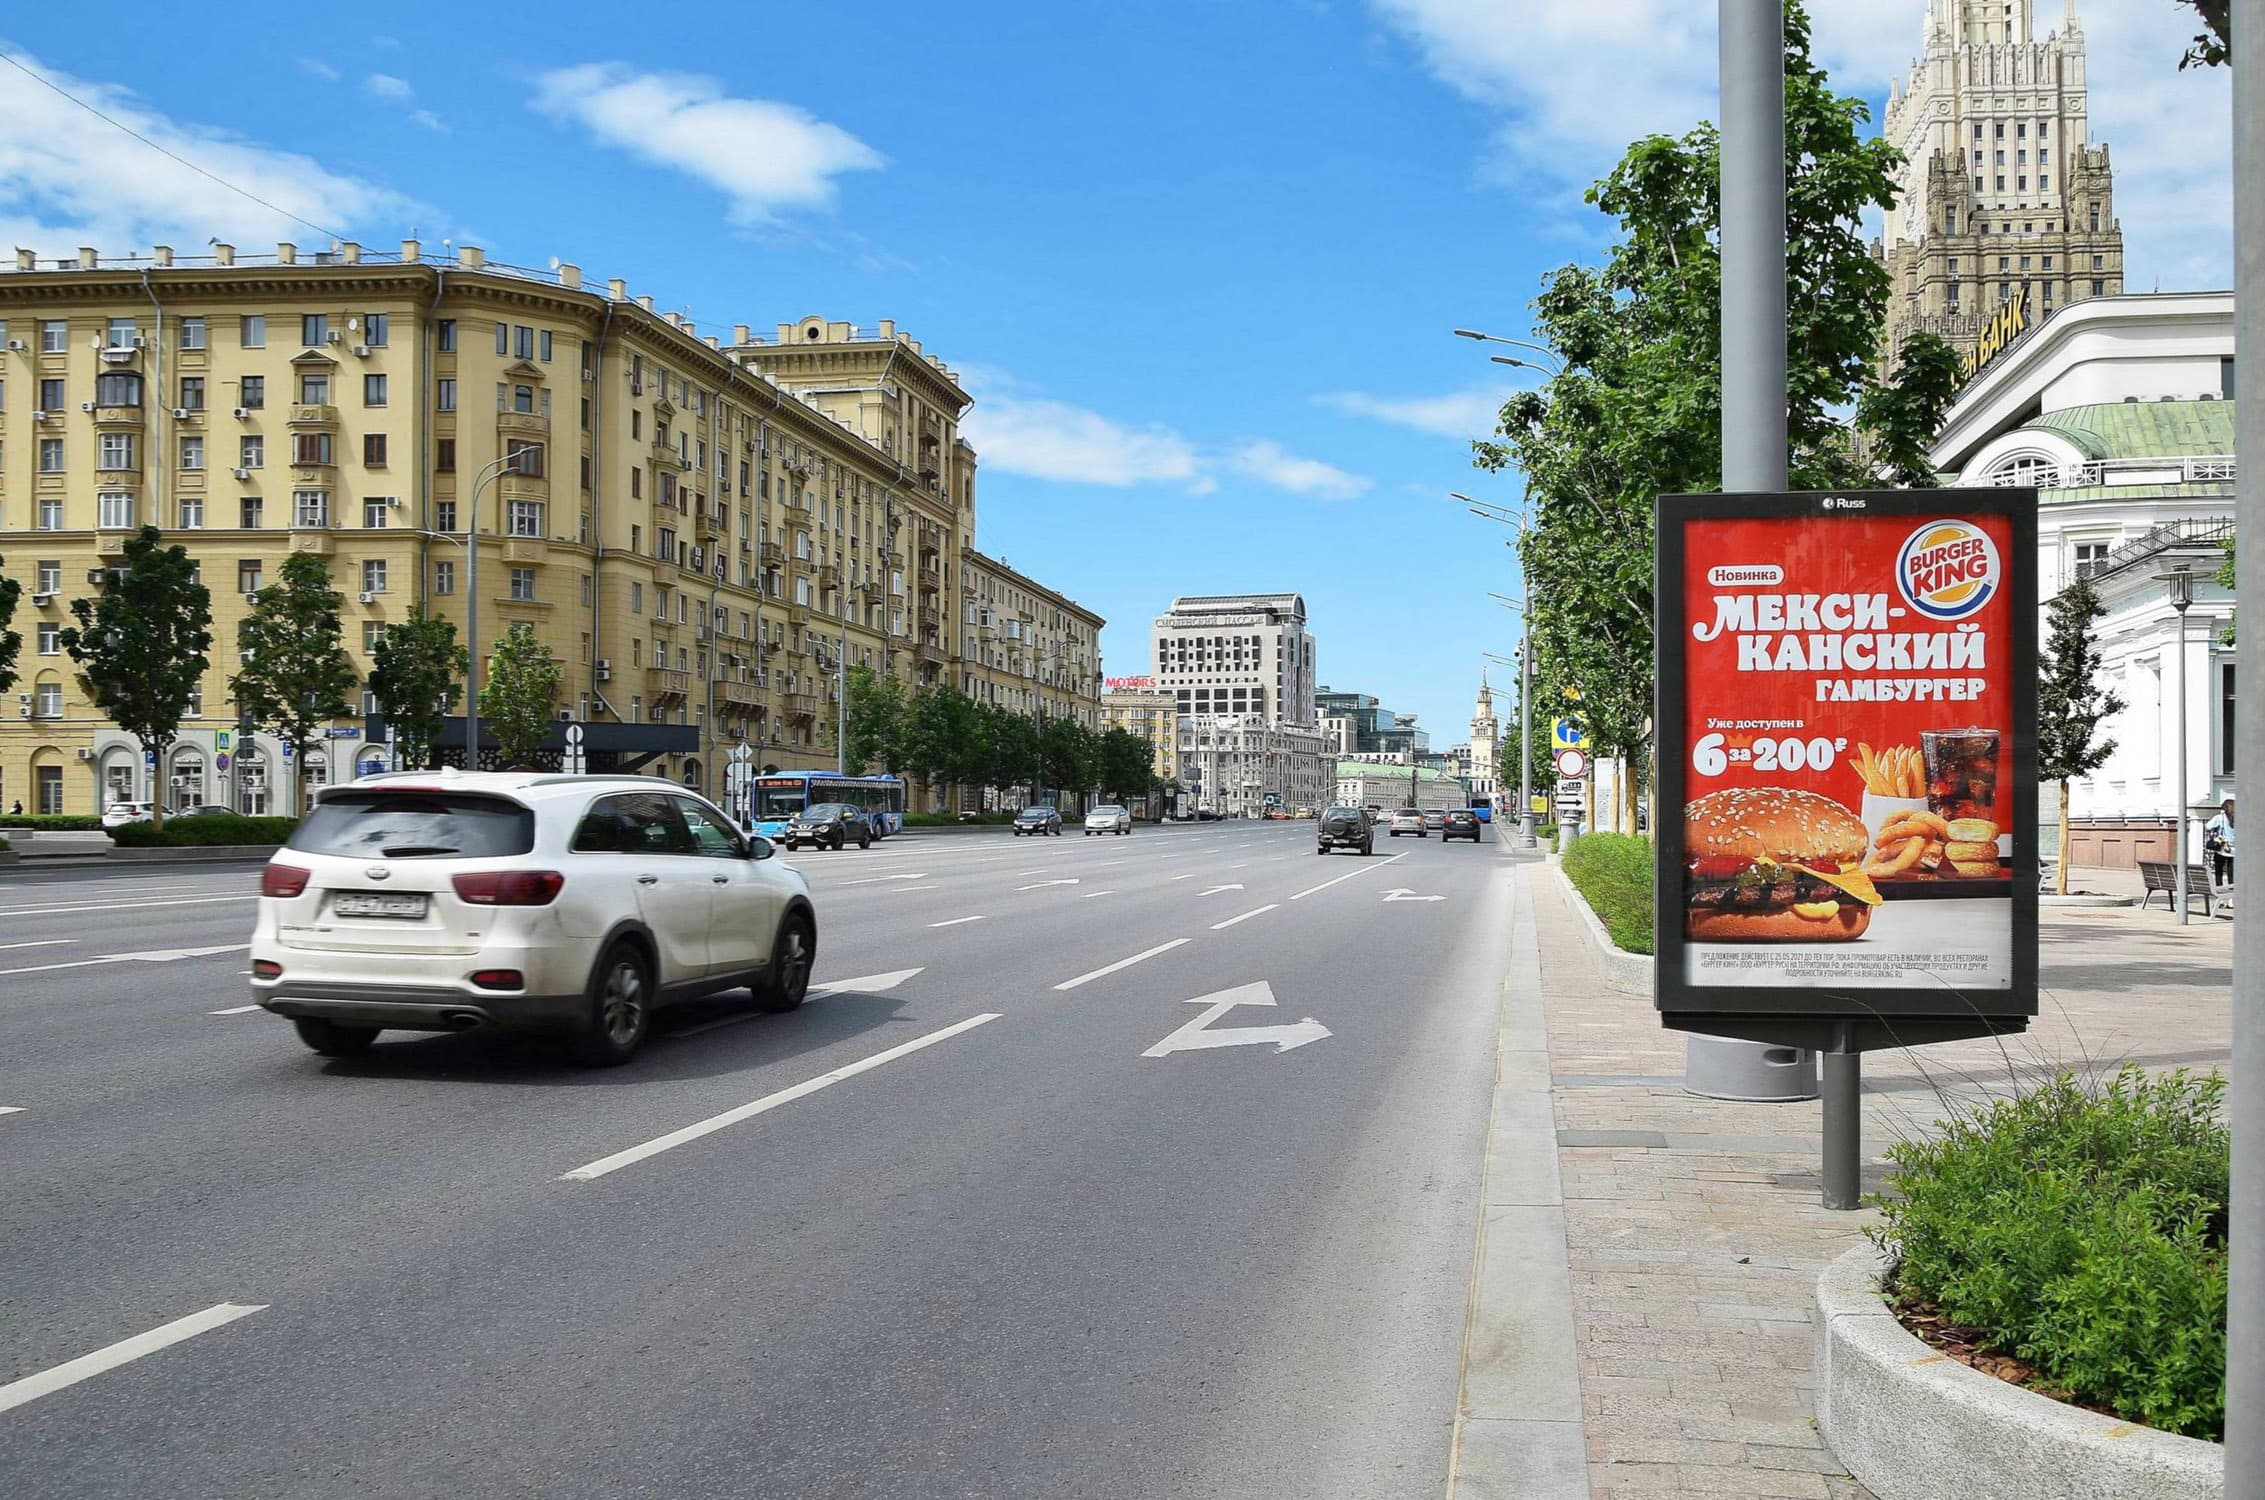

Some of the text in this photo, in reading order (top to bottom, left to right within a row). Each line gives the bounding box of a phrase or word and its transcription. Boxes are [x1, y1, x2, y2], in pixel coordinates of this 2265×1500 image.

[1980, 287, 2025, 367] БАНК
[1836, 498, 1866, 508] Russ
[1909, 537, 1984, 575] BURGER
[1714, 569, 1778, 582] Новинка
[1913, 554, 1988, 599] KING
[1224, 615, 1265, 626] ПАССАЖ
[1692, 593, 1907, 642] МЕКСИ-
[1737, 623, 1986, 671] КАНСКИЙ
[1105, 676, 1157, 688] MOTORS
[1816, 678, 1986, 702] ГАМБУРГЕР
[1706, 717, 1804, 731] Уже доступен в
[1693, 732, 1728, 777] 6
[1729, 748, 1752, 761] за
